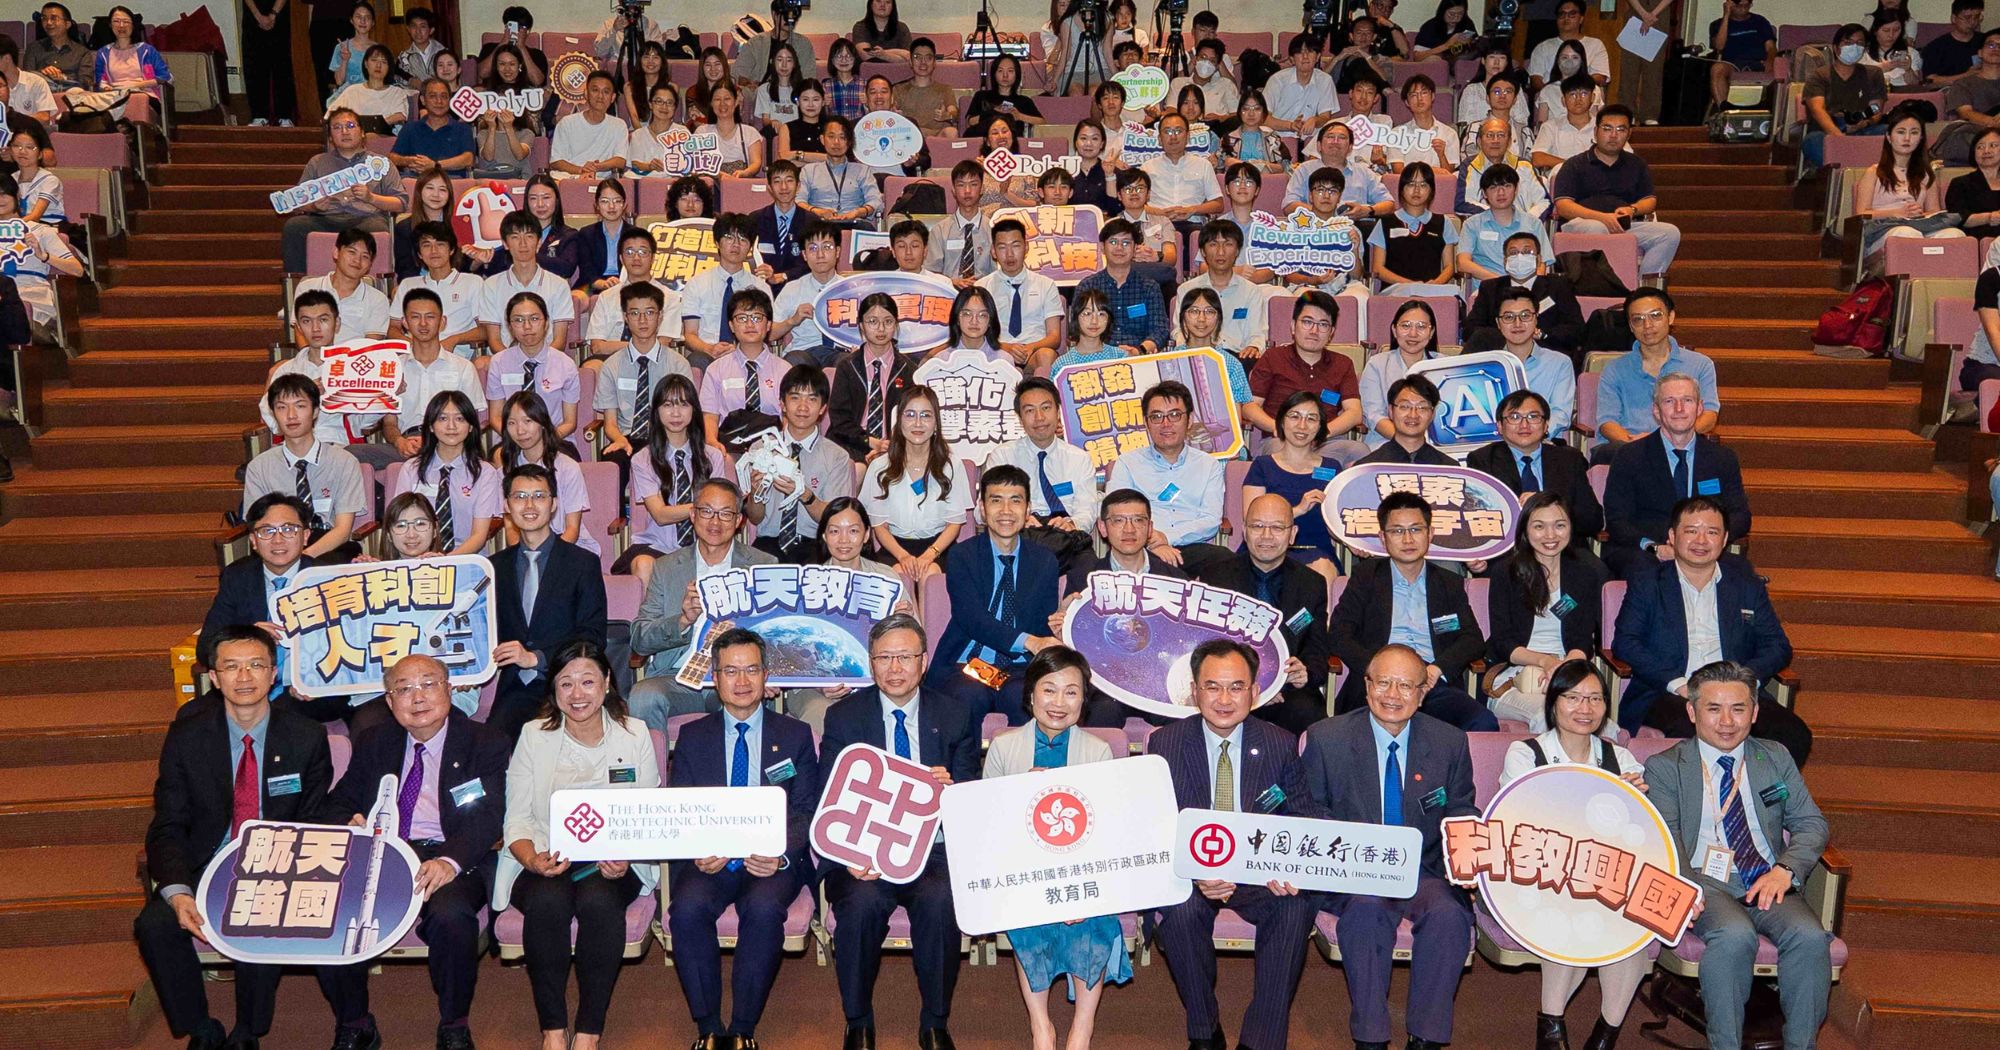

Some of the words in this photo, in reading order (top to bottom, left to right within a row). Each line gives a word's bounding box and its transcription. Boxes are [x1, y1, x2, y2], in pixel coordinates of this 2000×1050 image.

[485, 90, 543, 115] PolyU
[662, 131, 689, 147] We
[684, 134, 715, 151] did
[1126, 133, 1207, 147] Rewng
[1375, 127, 1433, 152] PolyU
[694, 152, 719, 170] it!
[274, 166, 372, 212] INSPIRING
[1252, 226, 1351, 246] Rewarding
[1250, 248, 1352, 266] Experience
[826, 293, 954, 327] 科實踐
[327, 377, 395, 389] Excellence
[329, 360, 345, 377] 卓
[379, 360, 397, 378] 越
[1067, 363, 1135, 403] 激發
[927, 376, 1005, 410] 強化
[1450, 380, 1498, 428] AI
[940, 409, 1027, 444] 學素養
[1075, 396, 1145, 436] 創新
[1376, 473, 1466, 507] 探索
[1341, 508, 1505, 541] 浩宇宙
[276, 564, 456, 638] 培育科創
[700, 567, 900, 622] 航天教育
[1092, 574, 1280, 645] 航天任務
[316, 622, 420, 683] 人才
[608, 803, 635, 814] THE
[638, 803, 677, 814] HONG
[680, 802, 716, 813] KONG
[608, 816, 697, 827] POLYTECHNIC
[699, 814, 774, 826] UNIVERSITY
[241, 827, 350, 876] 航天
[609, 829, 680, 841] 香港理工大學
[967, 850, 1171, 893] 中華人民共和國香港特別行政區政府
[1246, 860, 1281, 873] BANK
[1285, 863, 1301, 875] OF
[1305, 866, 1348, 878] CHINA
[1446, 820, 1698, 942] 科教興國
[229, 879, 341, 929] 強國
[1045, 881, 1100, 905] 教育局
